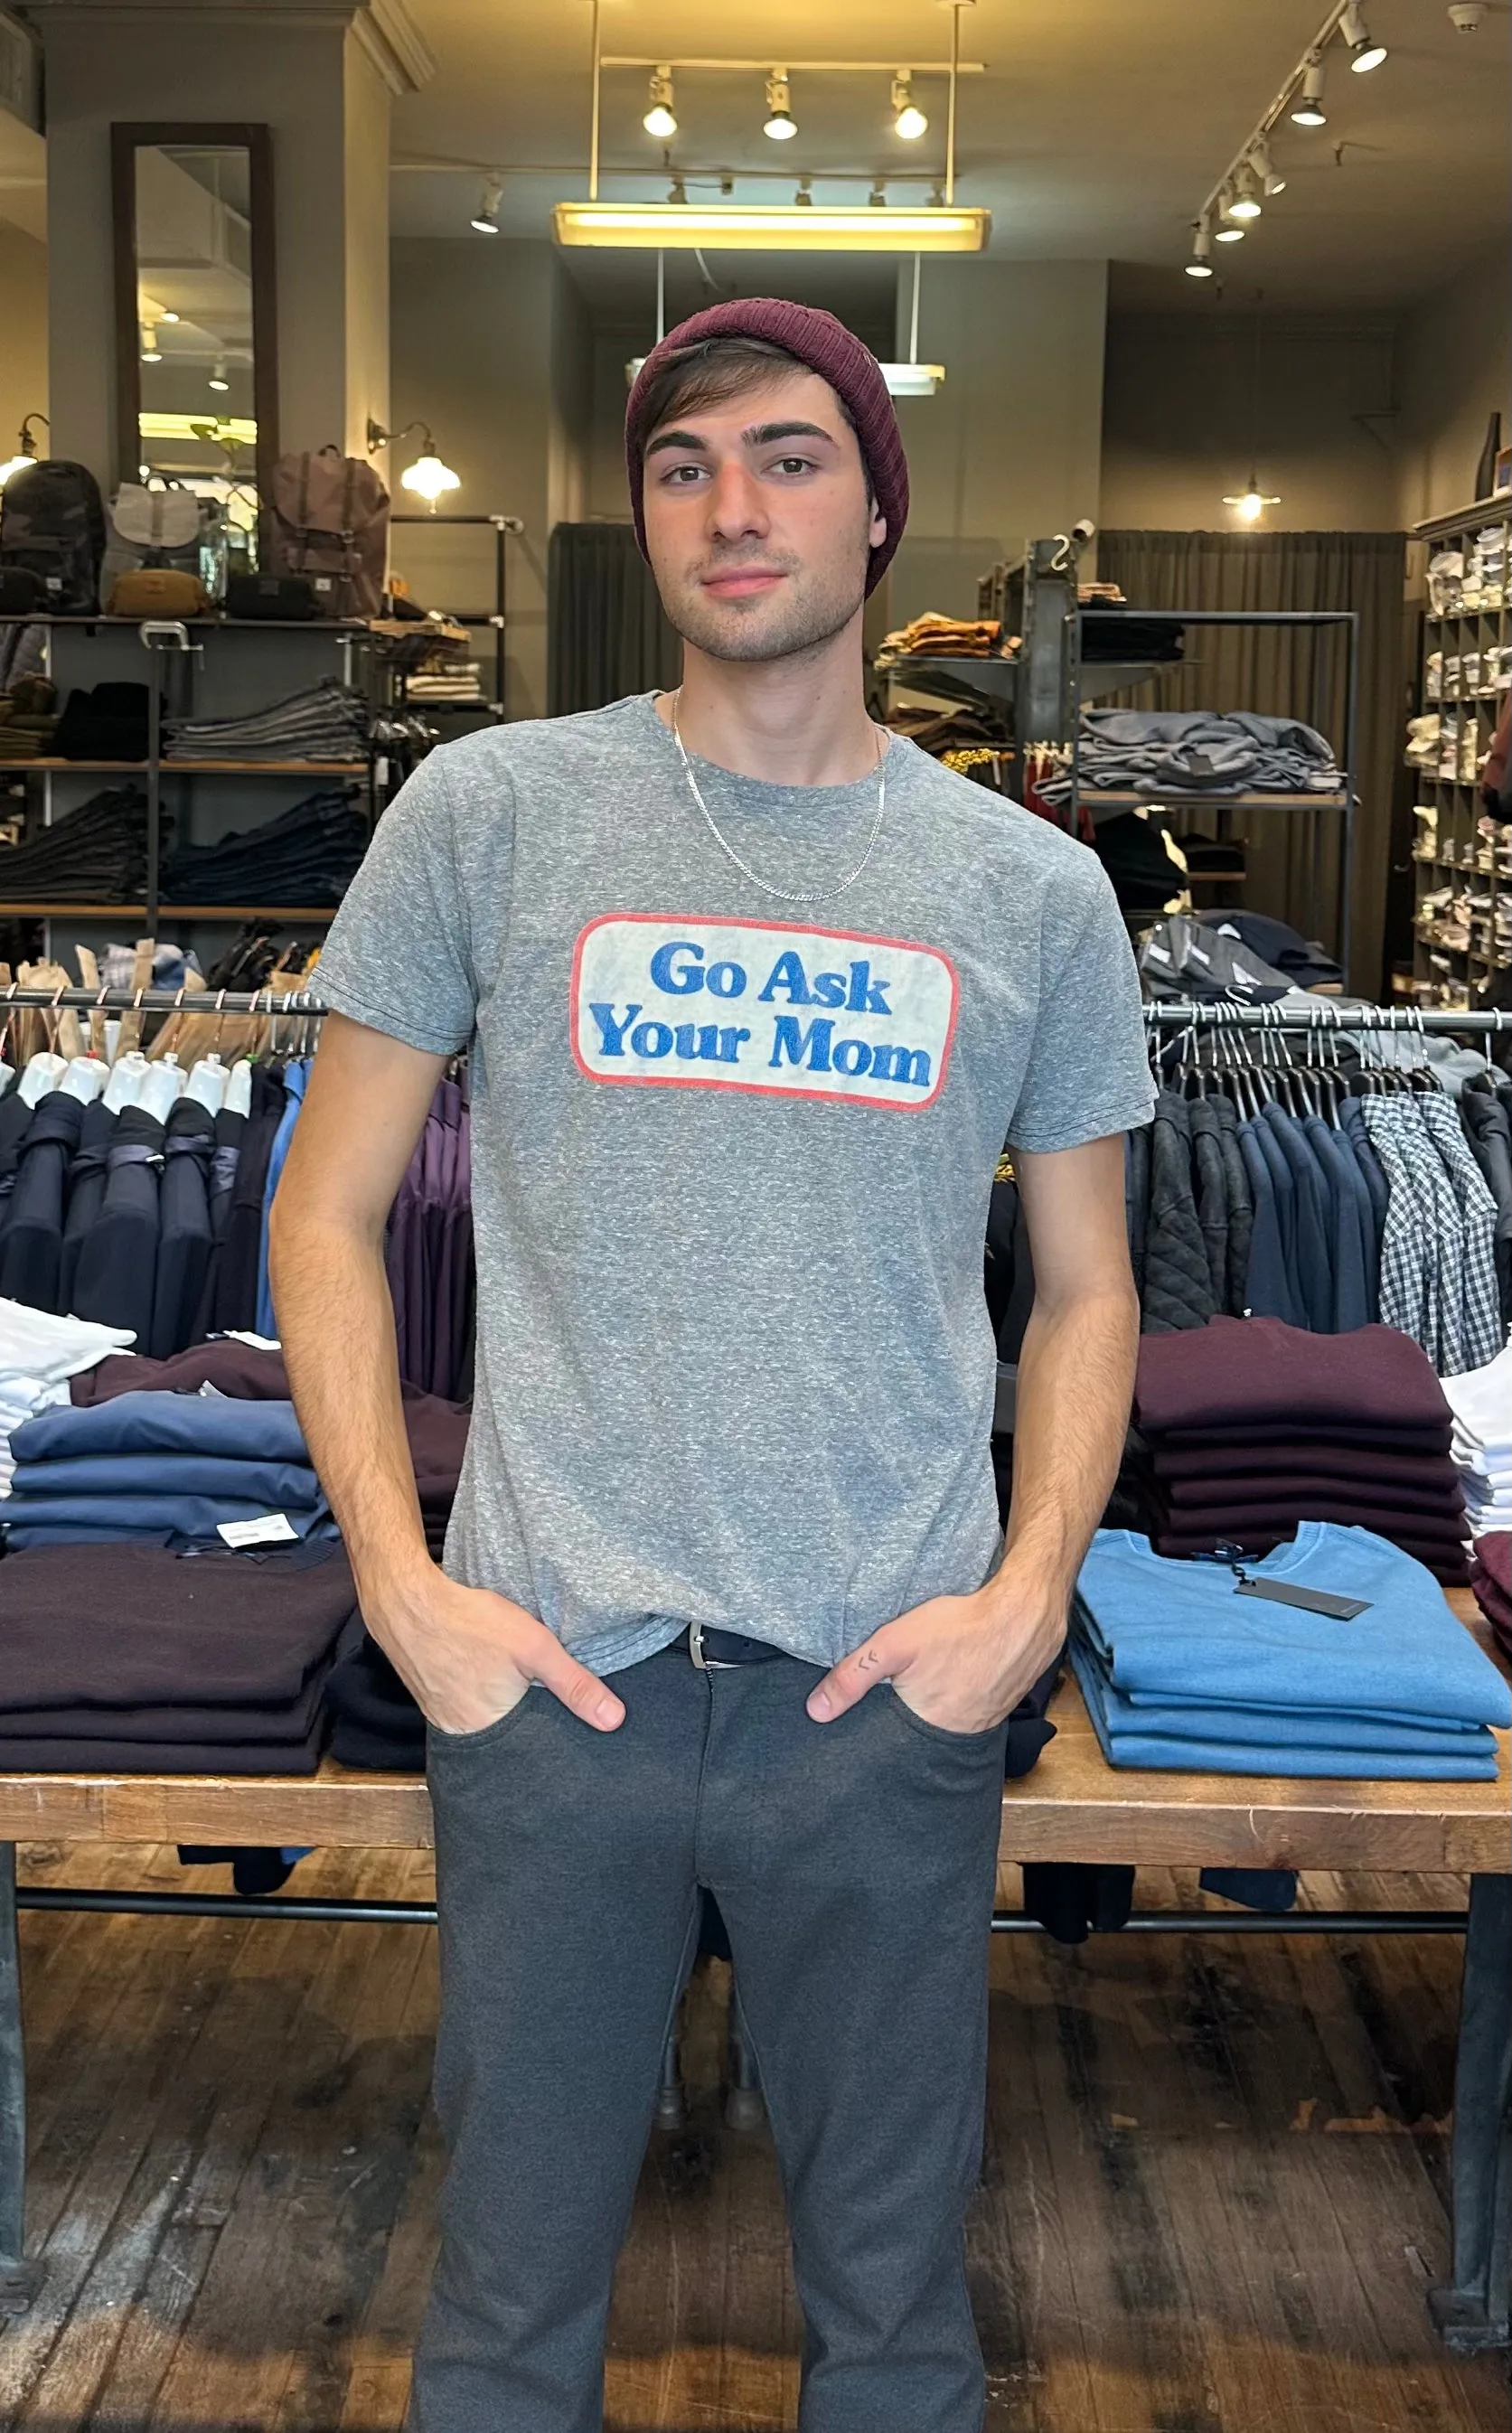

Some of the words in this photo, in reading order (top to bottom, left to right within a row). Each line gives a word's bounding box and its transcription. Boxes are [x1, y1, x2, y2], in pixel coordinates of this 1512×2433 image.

[651, 941, 747, 998] Go
[758, 951, 892, 1015] Ask
[589, 1003, 750, 1063] Your
[768, 1015, 931, 1086] Mom
